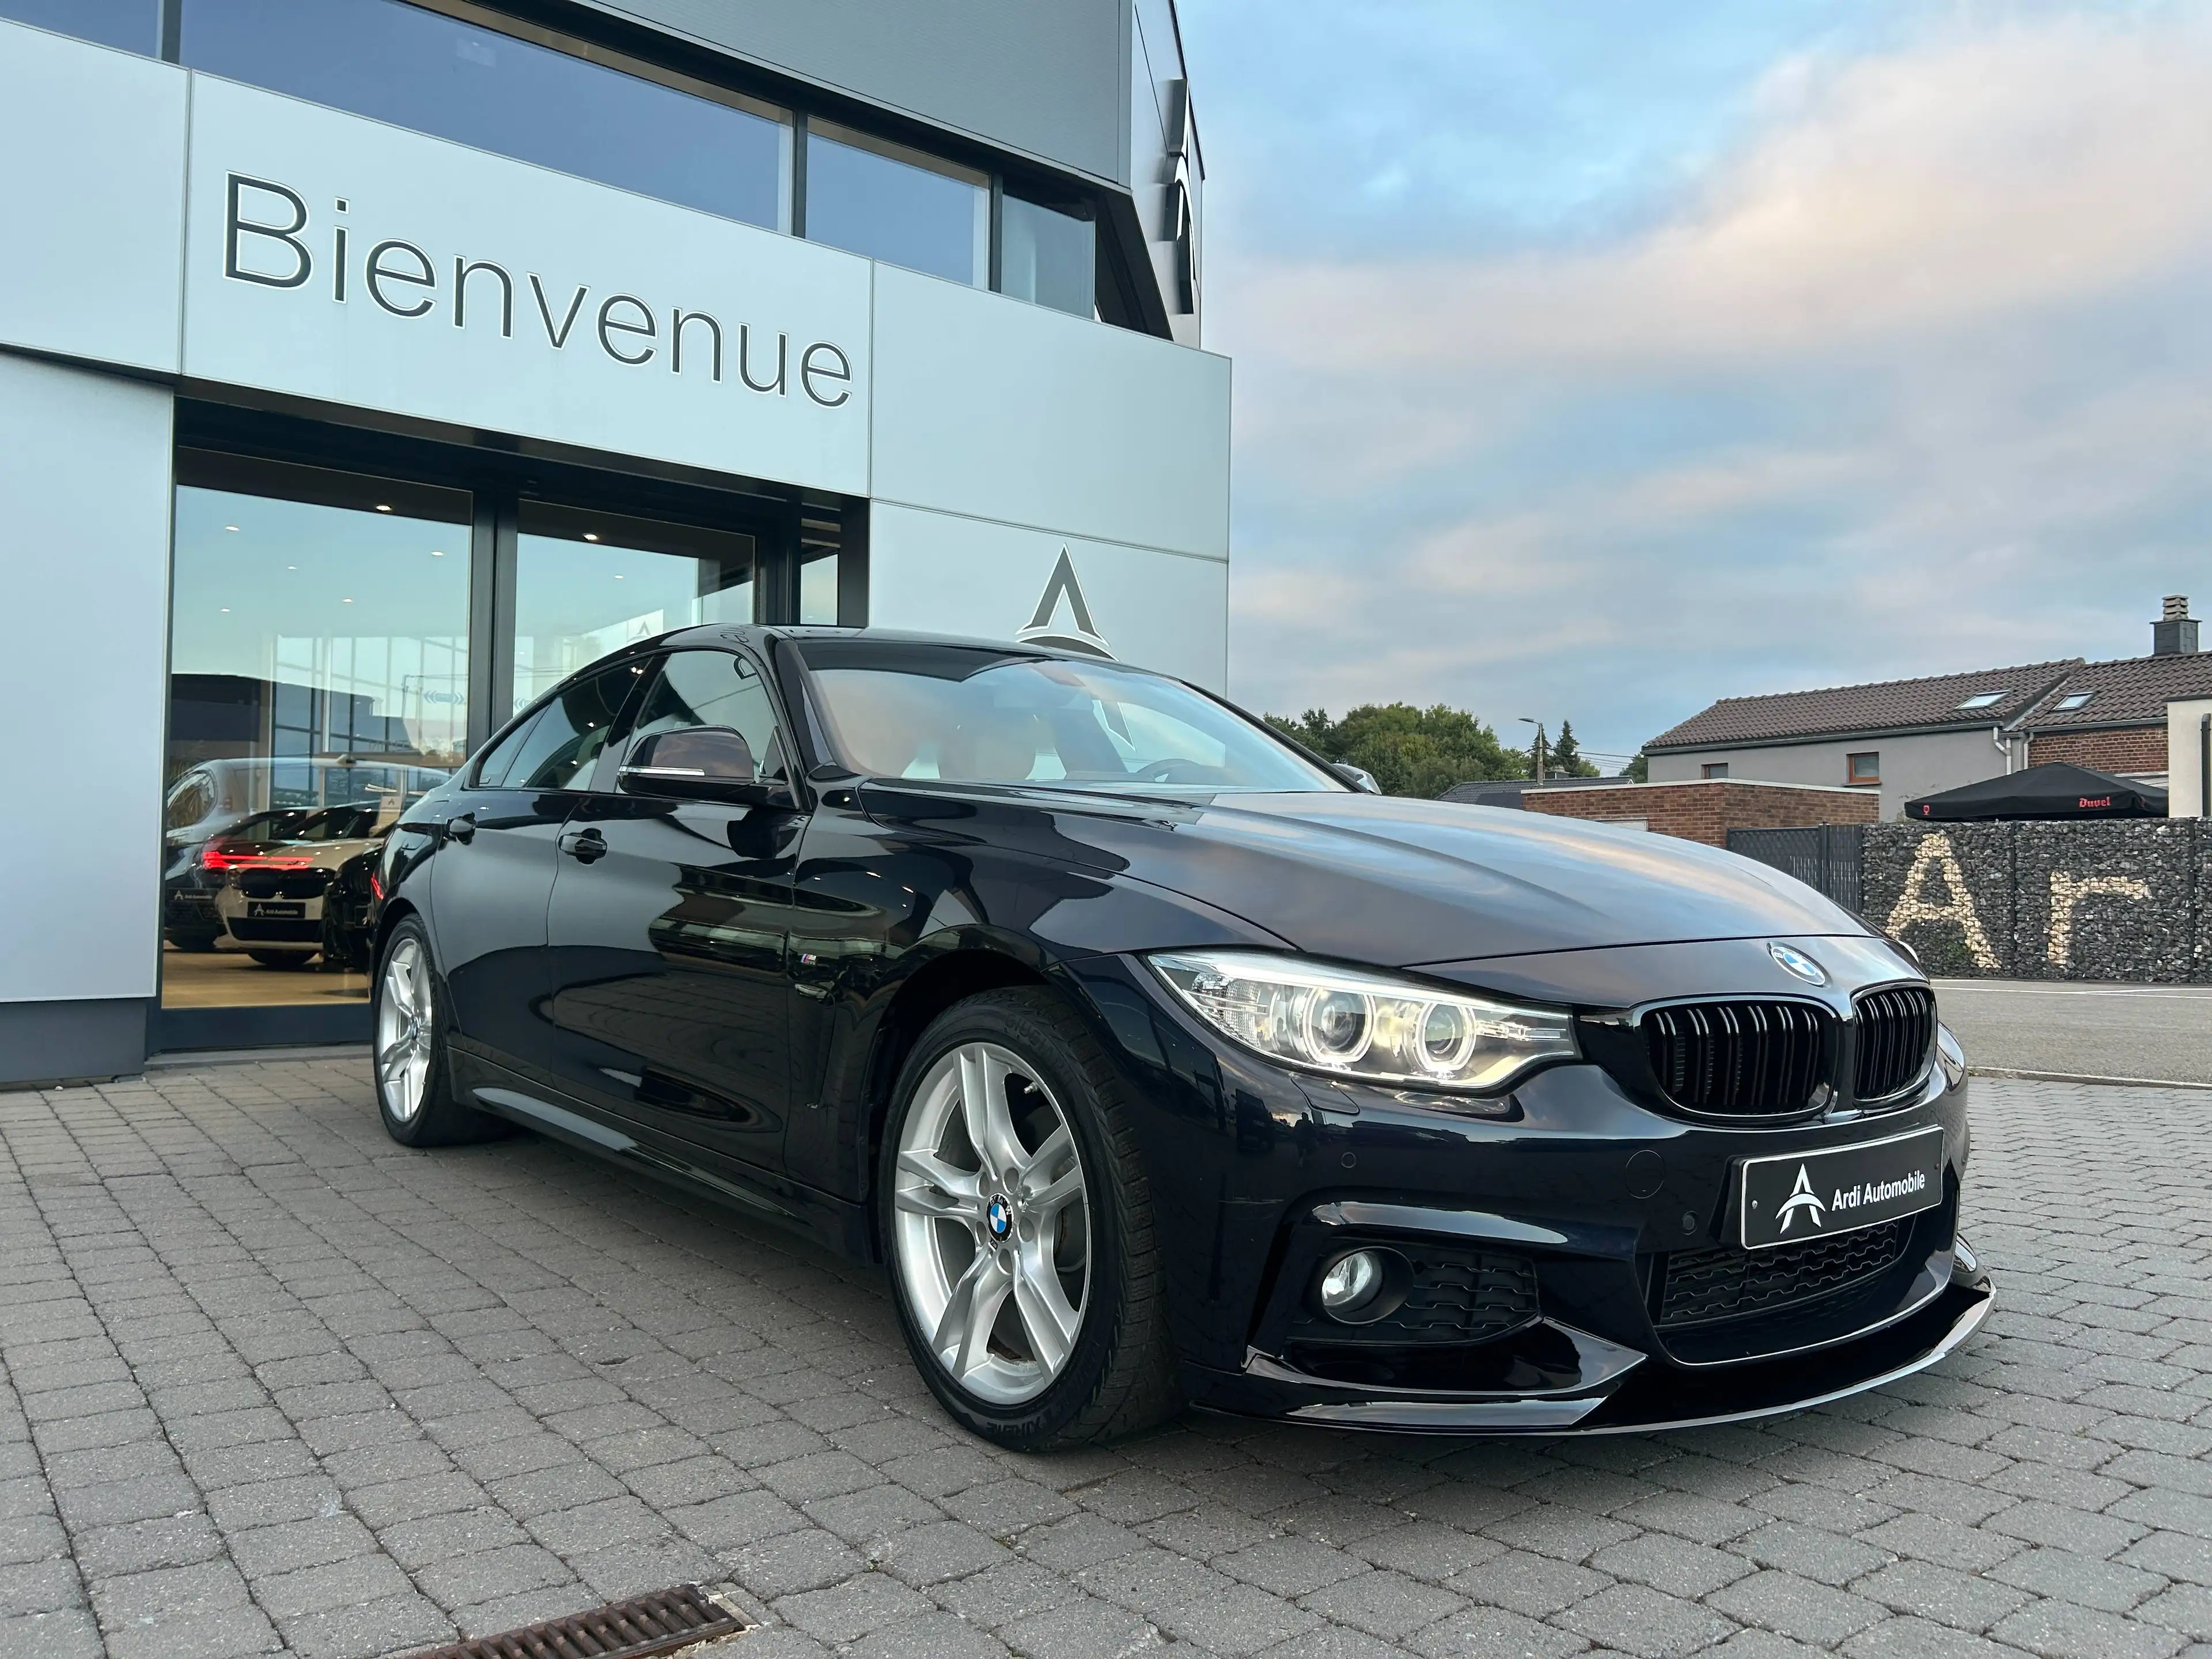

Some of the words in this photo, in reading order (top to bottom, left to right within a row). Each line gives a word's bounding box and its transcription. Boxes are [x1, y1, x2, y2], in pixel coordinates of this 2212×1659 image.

[223, 171, 854, 408] Bienvenue
[2079, 796, 2111, 808] Duvel
[1832, 1185, 1861, 1211] Ardi
[1863, 1169, 1925, 1205] Automobile
